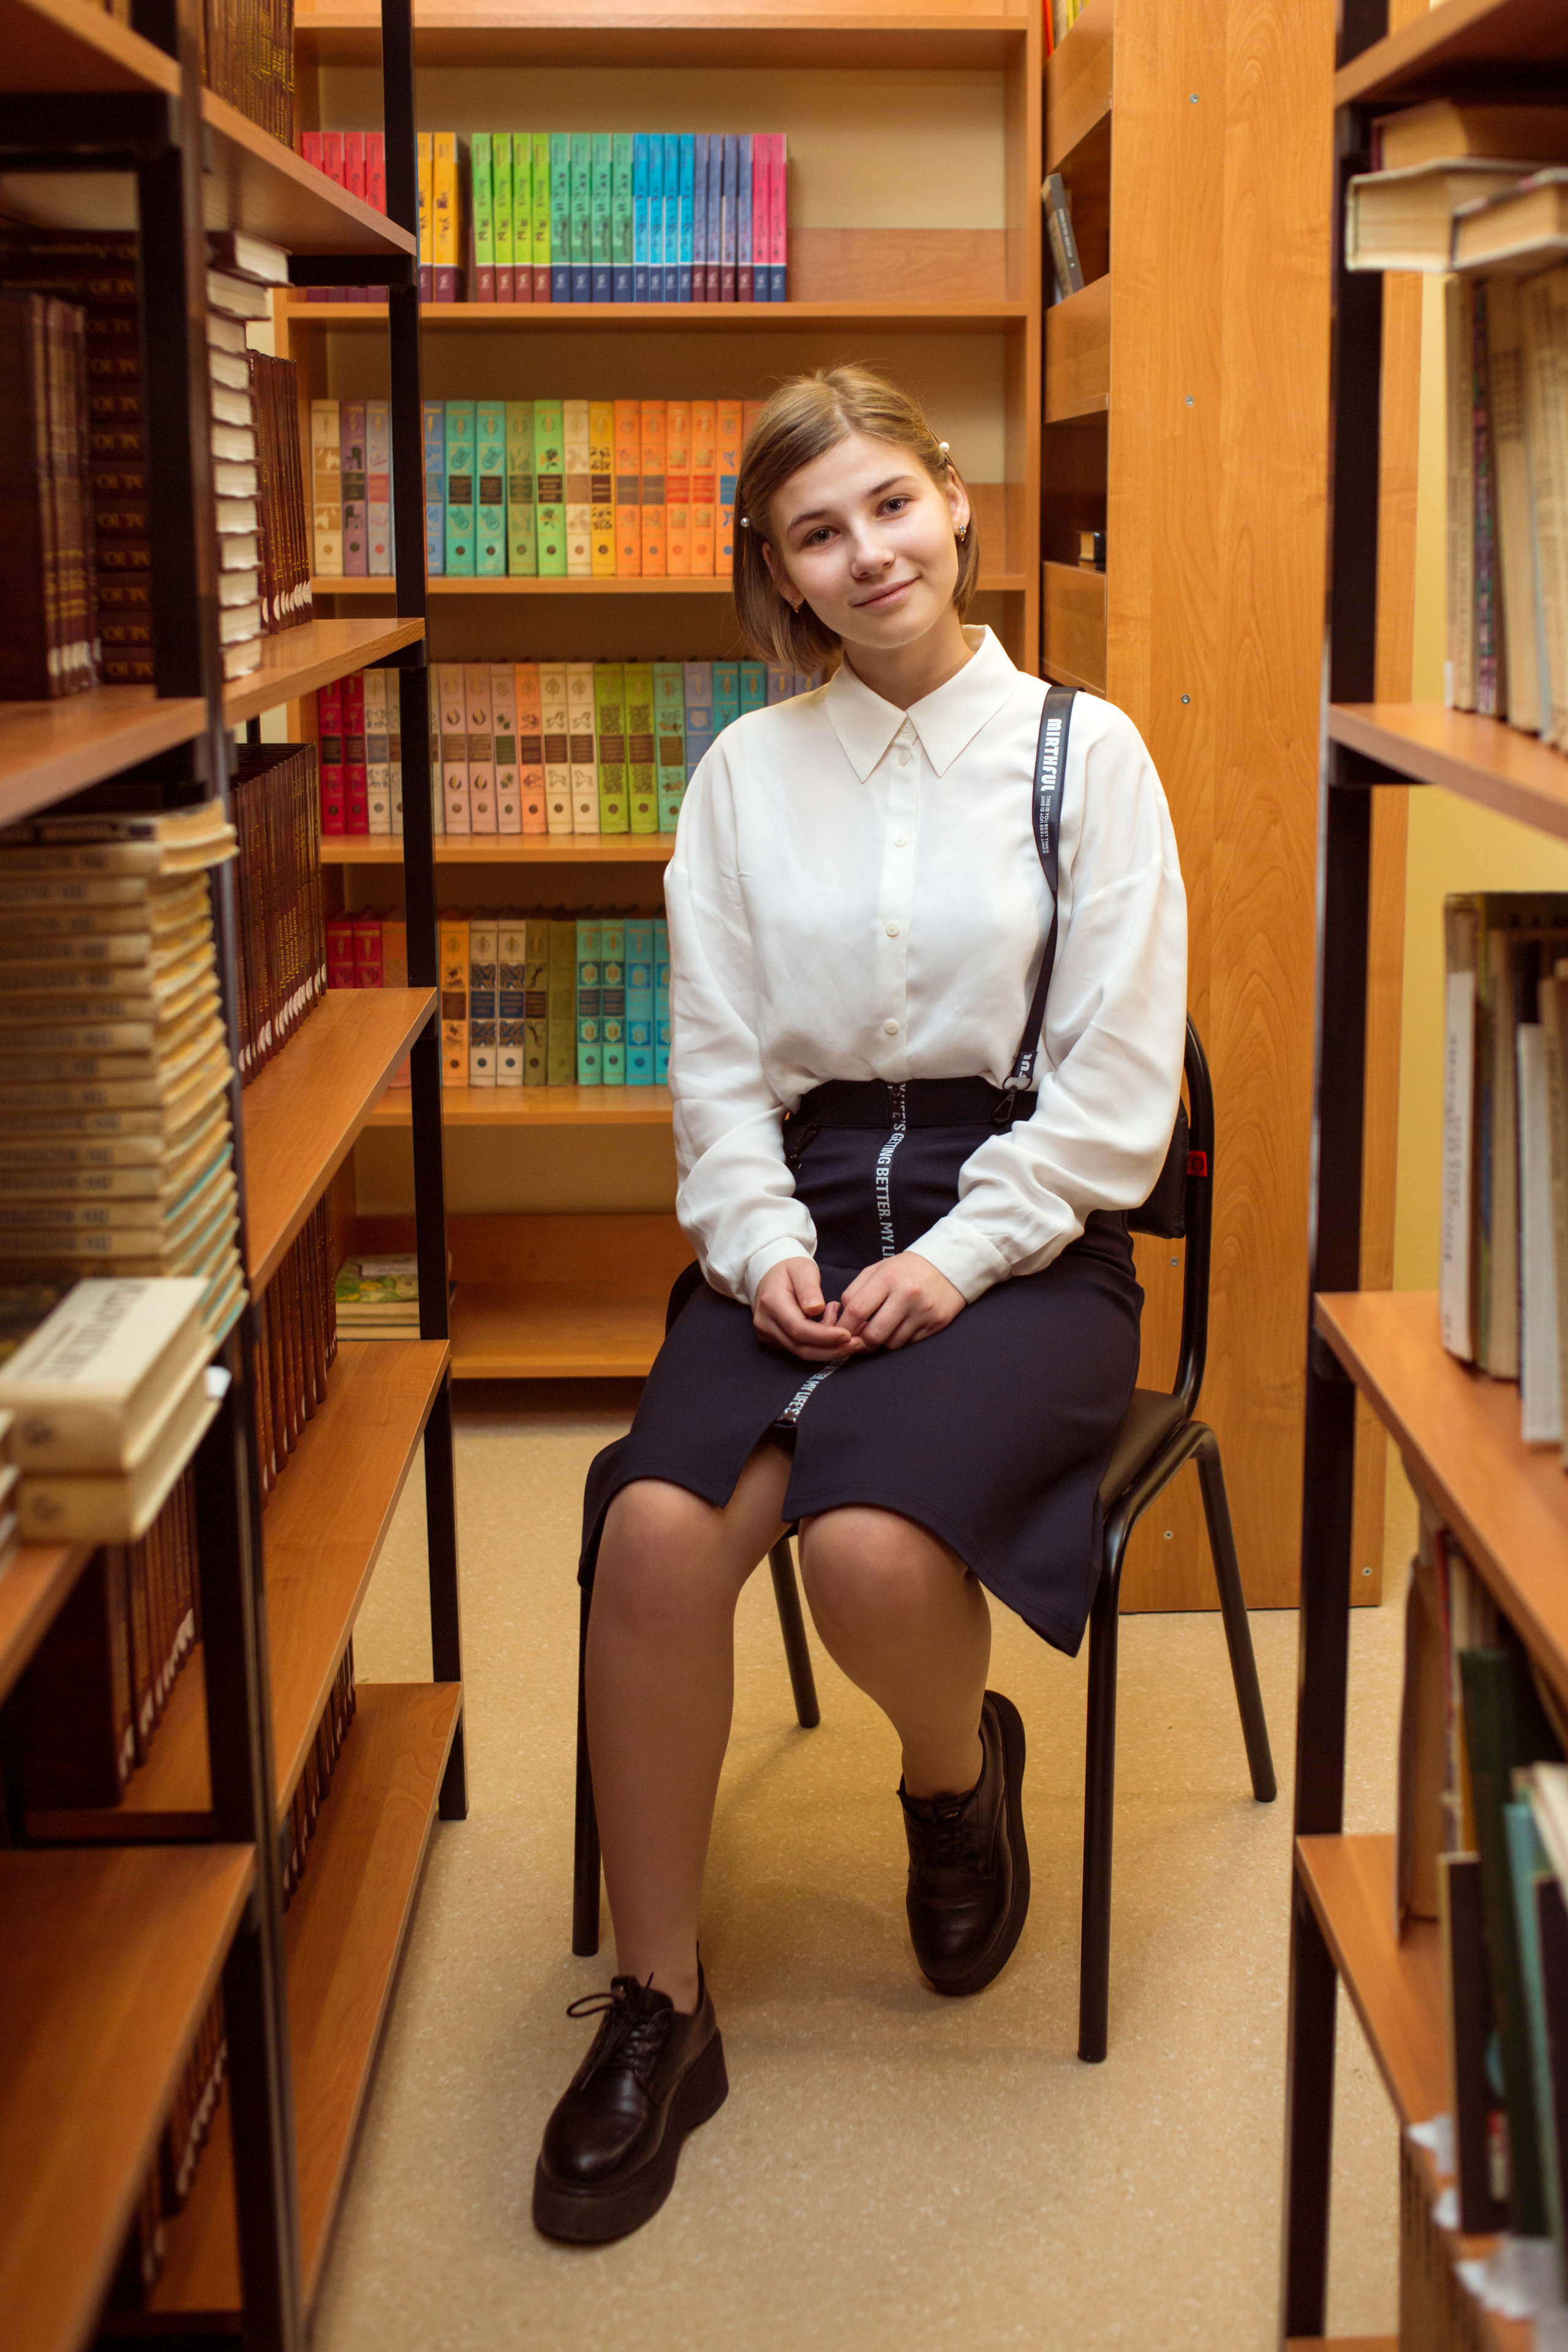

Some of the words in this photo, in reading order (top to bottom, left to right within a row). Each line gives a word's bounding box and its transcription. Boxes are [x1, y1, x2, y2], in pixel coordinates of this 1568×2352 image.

[1041, 718, 1062, 792] MIRTHFUL
[878, 1133, 904, 1164] GETTING
[875, 1167, 891, 1219] BETTER.
[880, 1222, 894, 1243] MY
[801, 1381, 820, 1392] MY
[784, 1392, 811, 1415] LIFE'S
